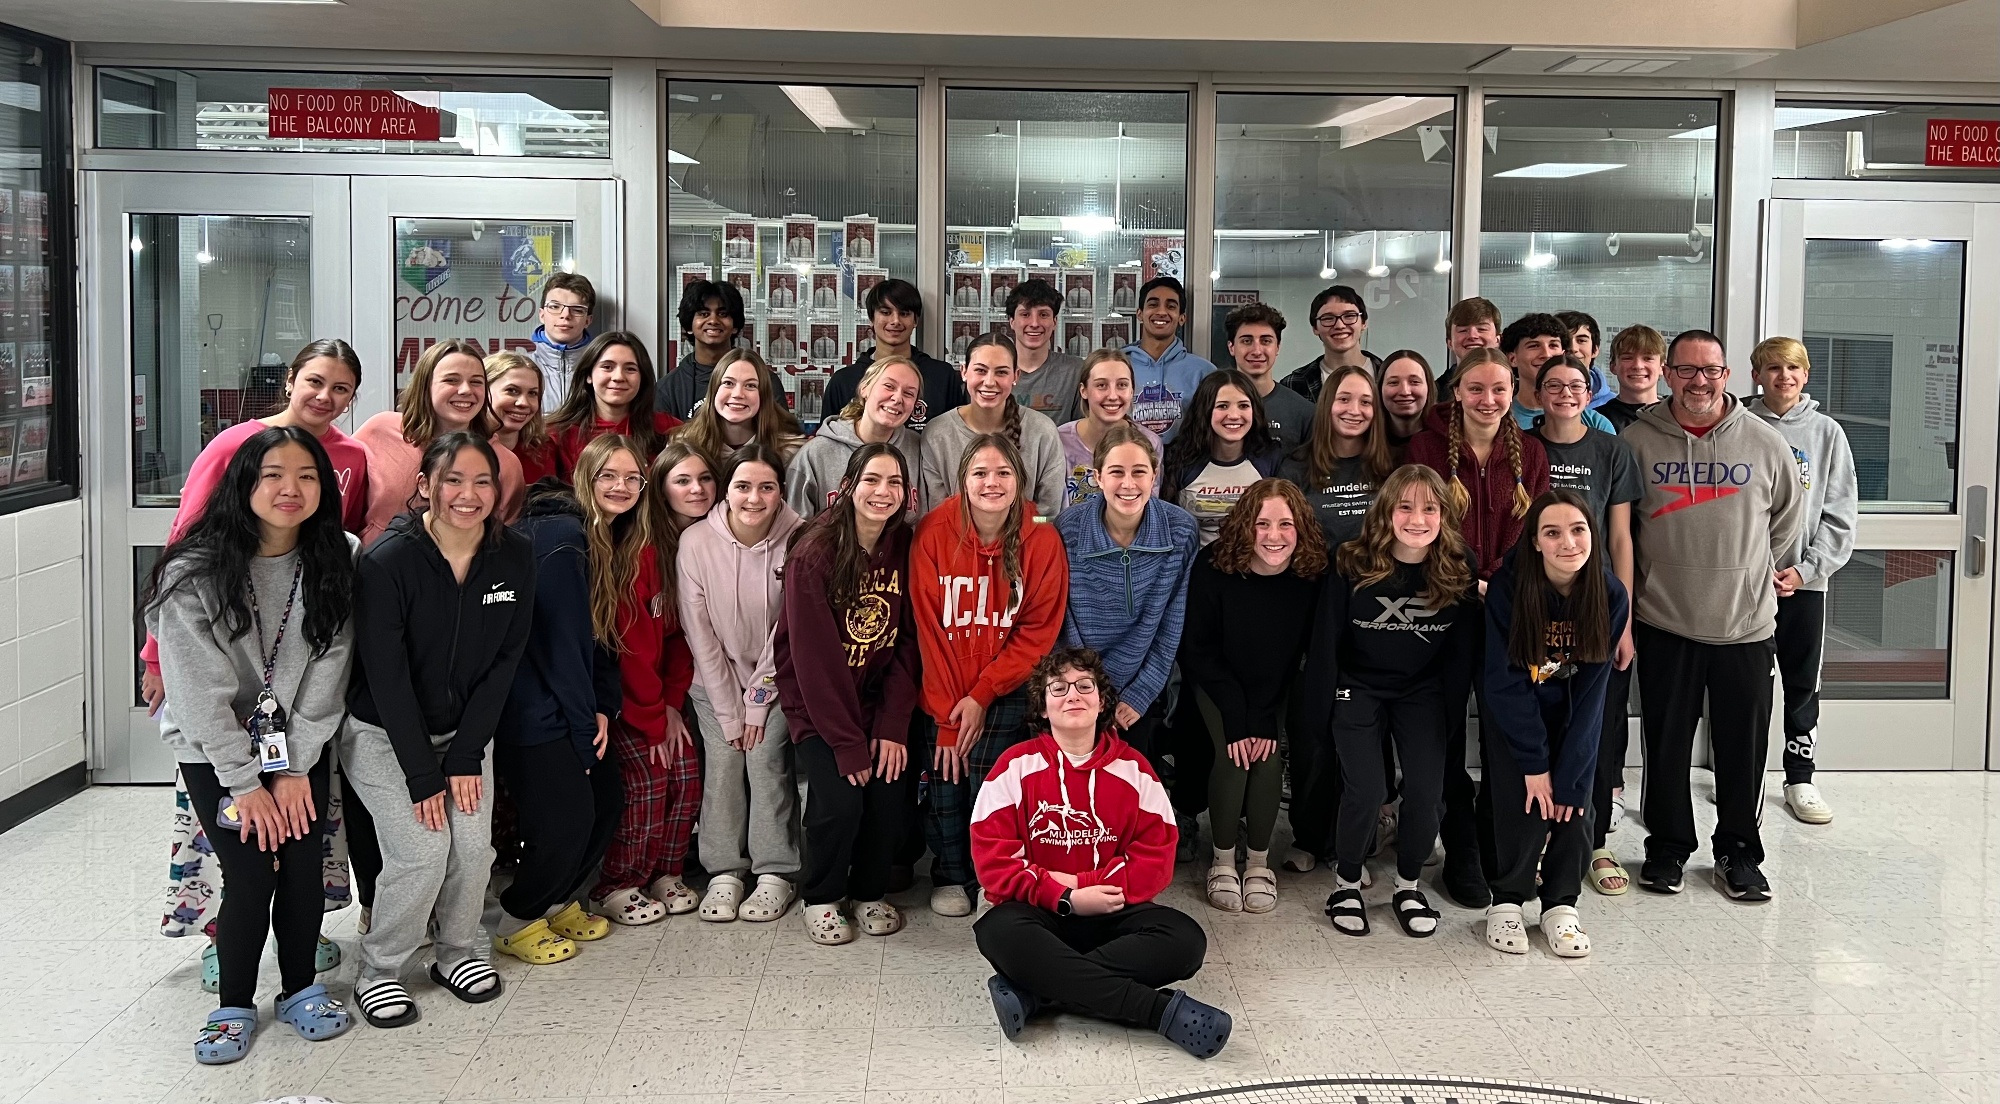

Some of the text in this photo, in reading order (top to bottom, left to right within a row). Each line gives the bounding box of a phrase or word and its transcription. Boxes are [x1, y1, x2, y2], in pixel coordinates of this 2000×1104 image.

[269, 93, 289, 111] NO
[297, 94, 336, 112] FOOD
[343, 95, 363, 112] OR
[370, 96, 416, 113] DRINK
[270, 115, 417, 135] THE BALCONY AREA
[1930, 125, 2000, 142] NO FOOD O
[1929, 145, 2000, 163] THE BALCO
[947, 234, 983, 245] ERTYVILLE
[495, 283, 537, 323] to
[1651, 462, 1752, 486] SPEEDO
[1197, 485, 1251, 495] ATLANT
[1322, 481, 1373, 494] mundelei
[493, 590, 517, 604] FORCE
[1373, 596, 1441, 624] XP
[1352, 618, 1454, 633] PERFORMANC
[1039, 834, 1118, 847] SWIMMNG & DVING
[1049, 827, 1110, 839] MUNDELEN
